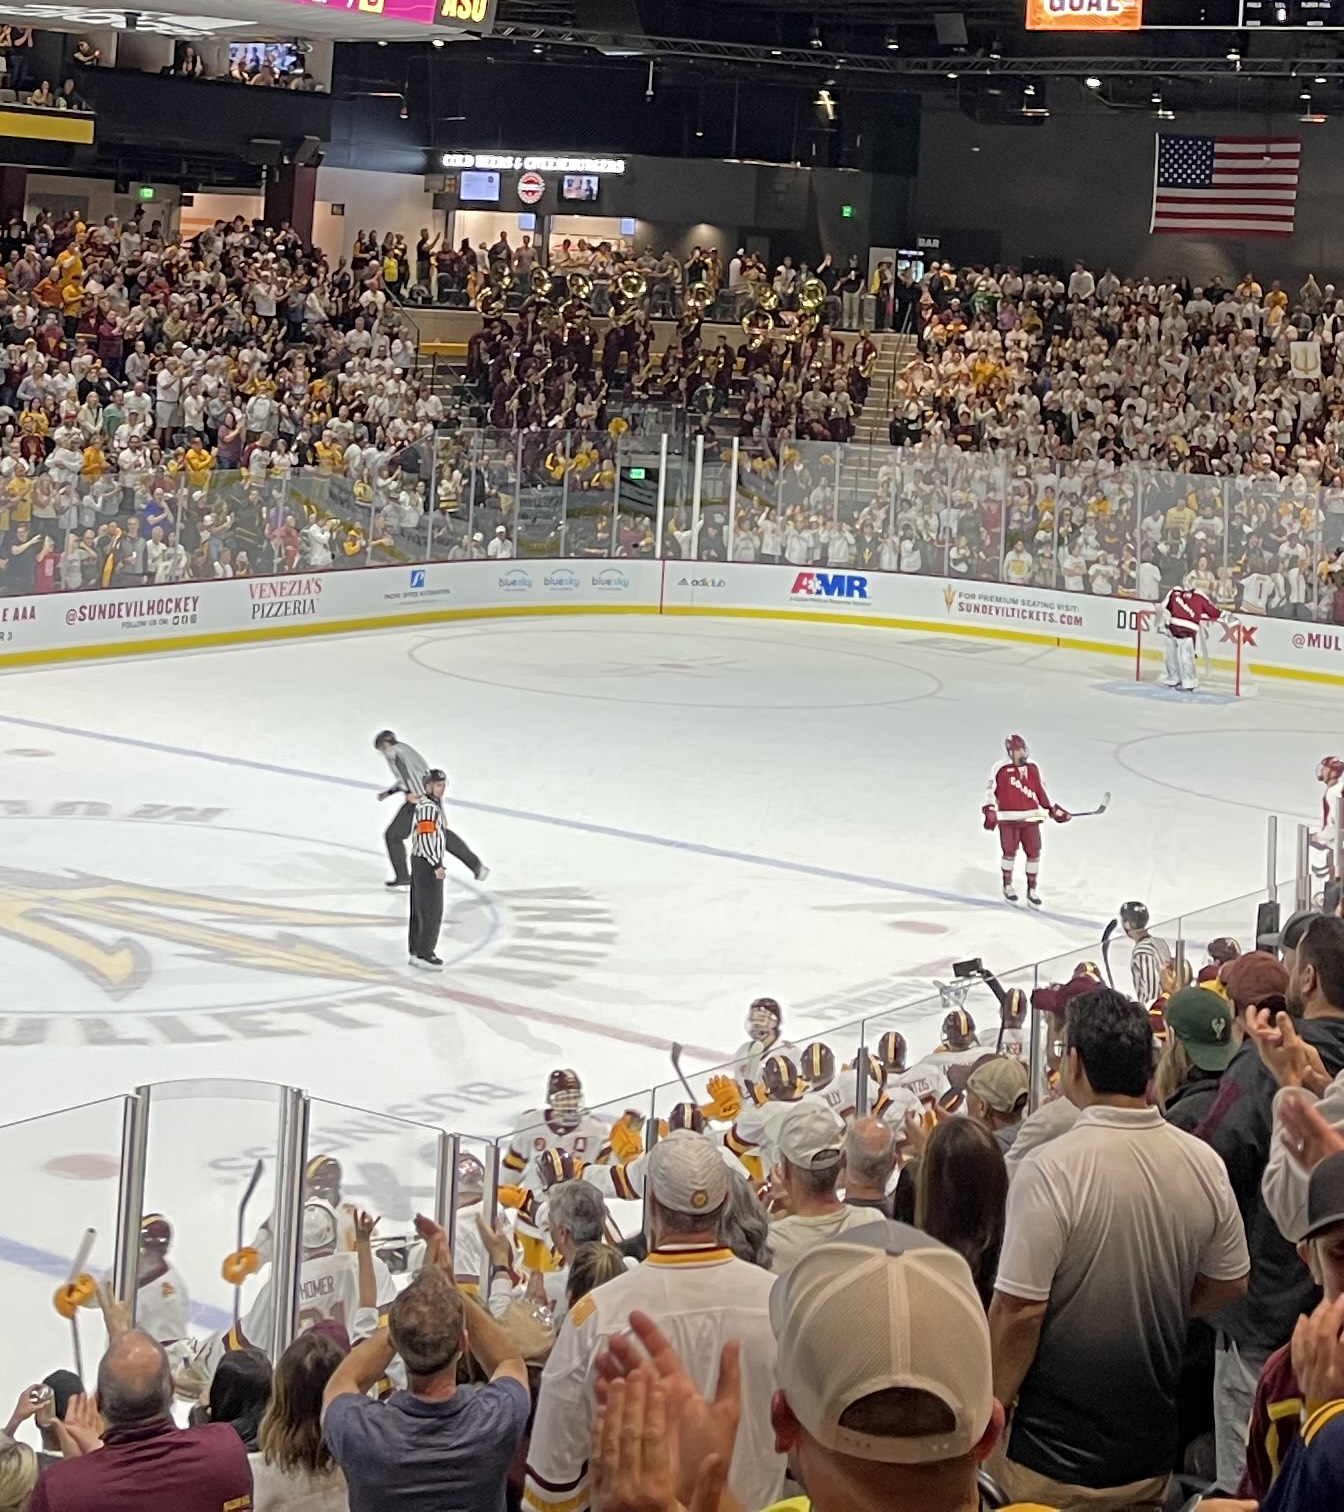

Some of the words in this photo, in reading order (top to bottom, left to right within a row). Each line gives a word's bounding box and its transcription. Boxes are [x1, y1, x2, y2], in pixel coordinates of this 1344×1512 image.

[918, 238, 940, 248] BAR
[249, 577, 322, 599] VENEZIA'S
[791, 572, 868, 599] AMR
[66, 596, 199, 625] @SUNDEVILHOCKEY
[251, 599, 316, 619] PIZZERIA
[958, 592, 976, 600] FOR
[978, 593, 1018, 604] PREMIUM
[1021, 599, 1055, 608] SEATING
[13, 605, 37, 621] AAA
[958, 602, 1083, 626] SUNDEVILTICKETS.COM
